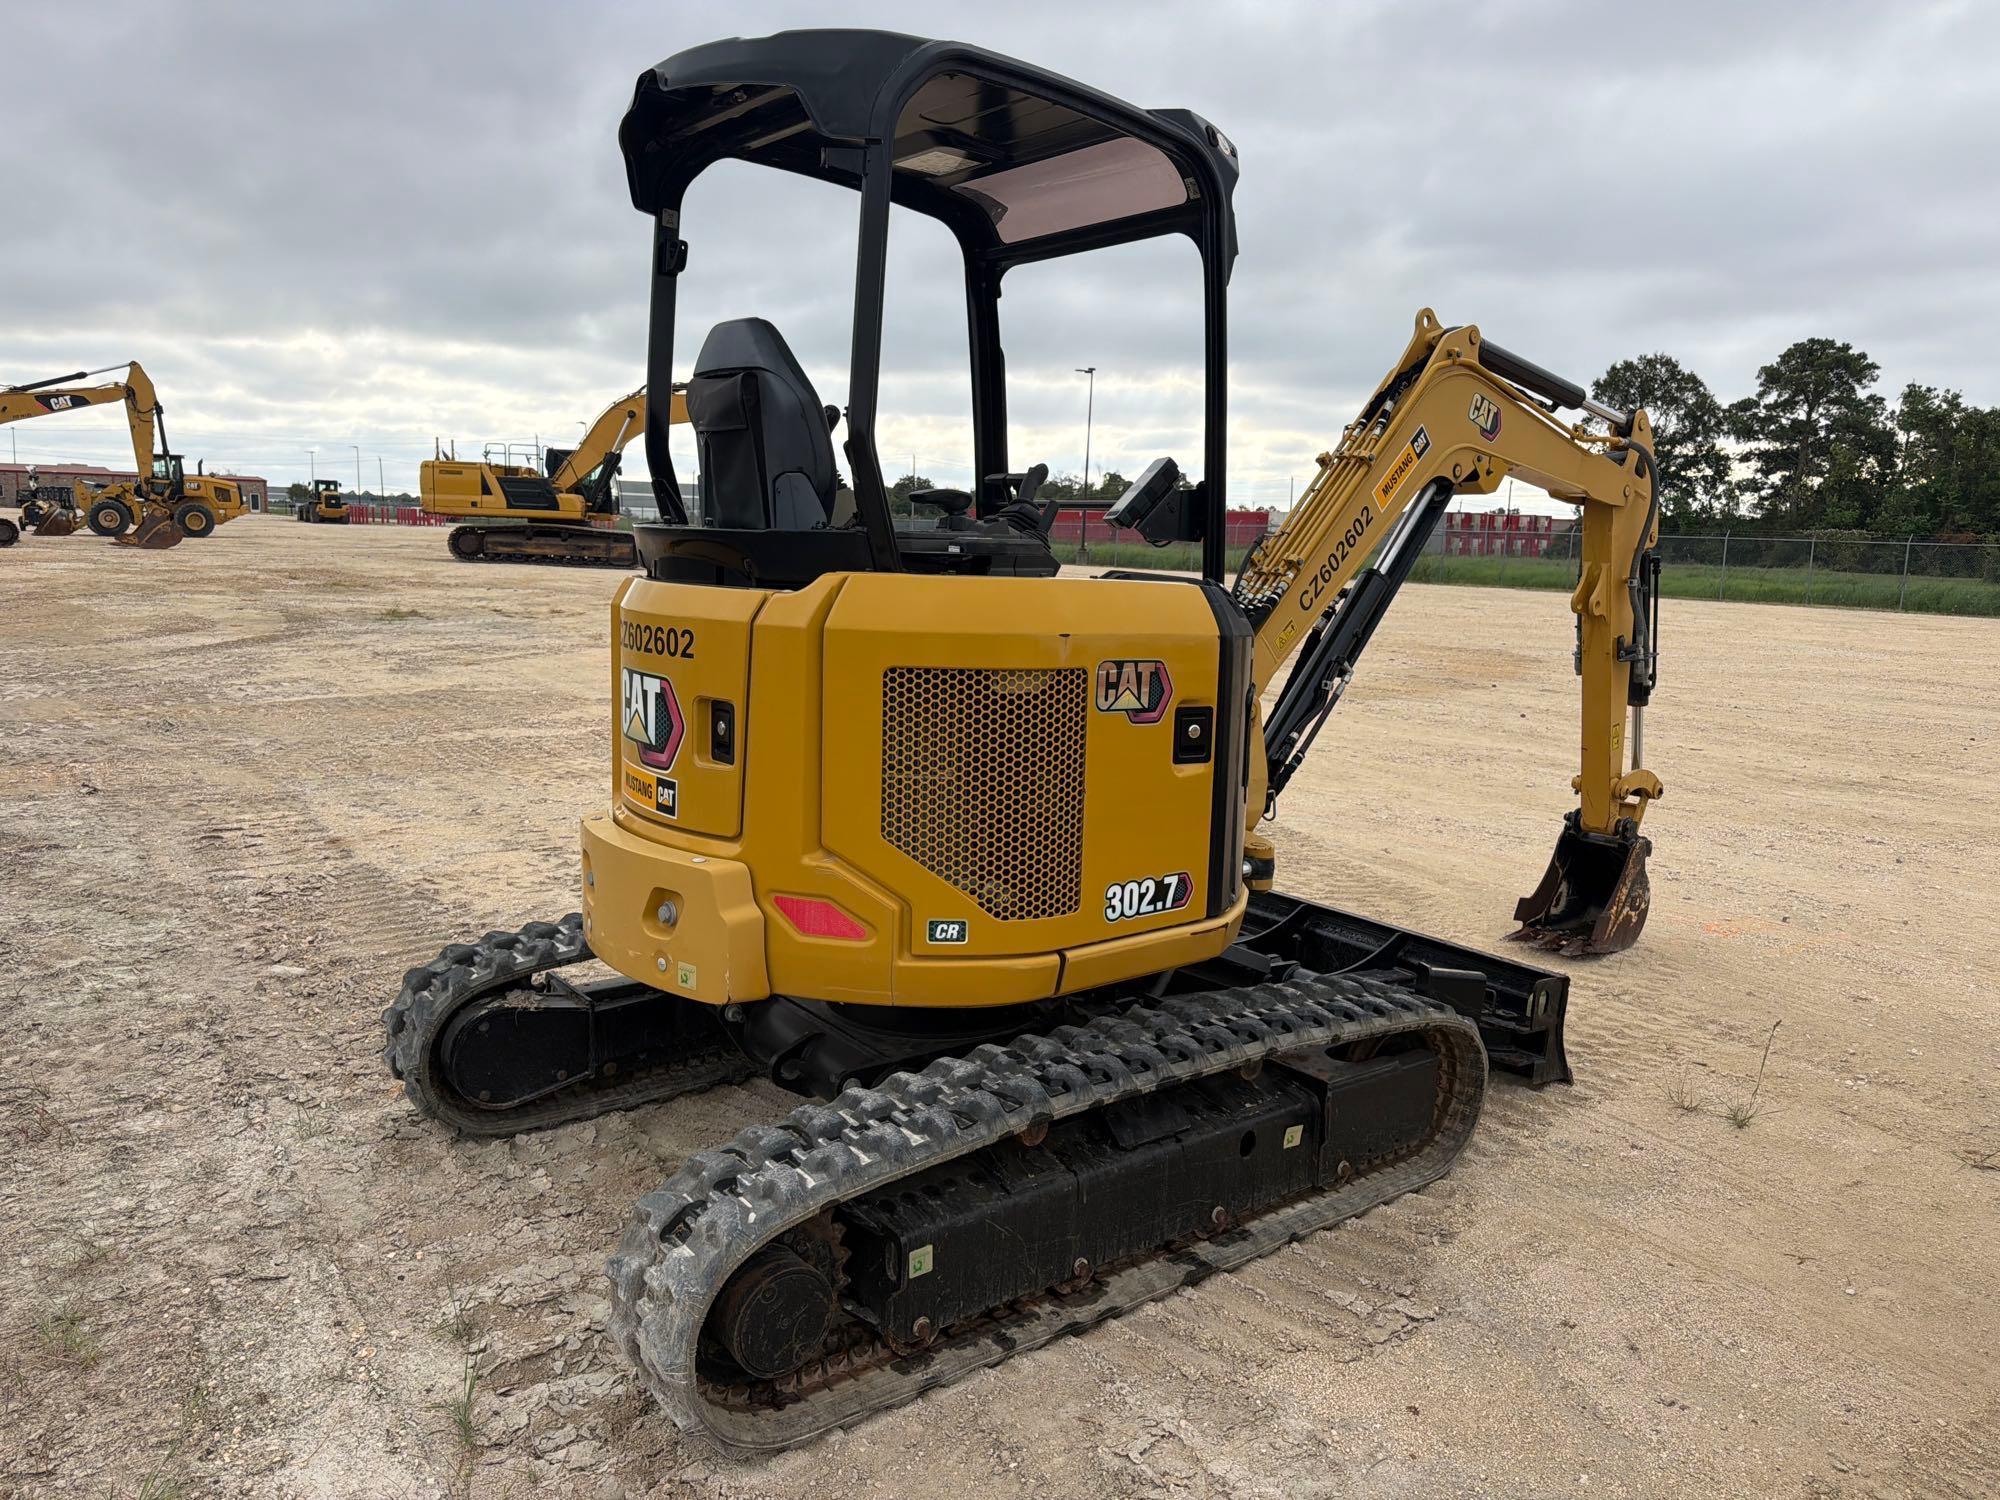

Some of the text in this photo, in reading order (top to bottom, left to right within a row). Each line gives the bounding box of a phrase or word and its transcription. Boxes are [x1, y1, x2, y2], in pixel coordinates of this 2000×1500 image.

[50, 395, 72, 410] CAT
[1470, 393, 1498, 431] CAT
[1381, 432, 1427, 498] MUSTANG CAT
[1299, 505, 1374, 611] CZ602602
[620, 620, 694, 659] Z602602
[622, 668, 661, 746] CAT
[1096, 661, 1156, 710] CAT
[625, 770, 674, 807] MUSTANG CAT
[1104, 874, 1179, 921] 302.7
[935, 923, 960, 939] CR
